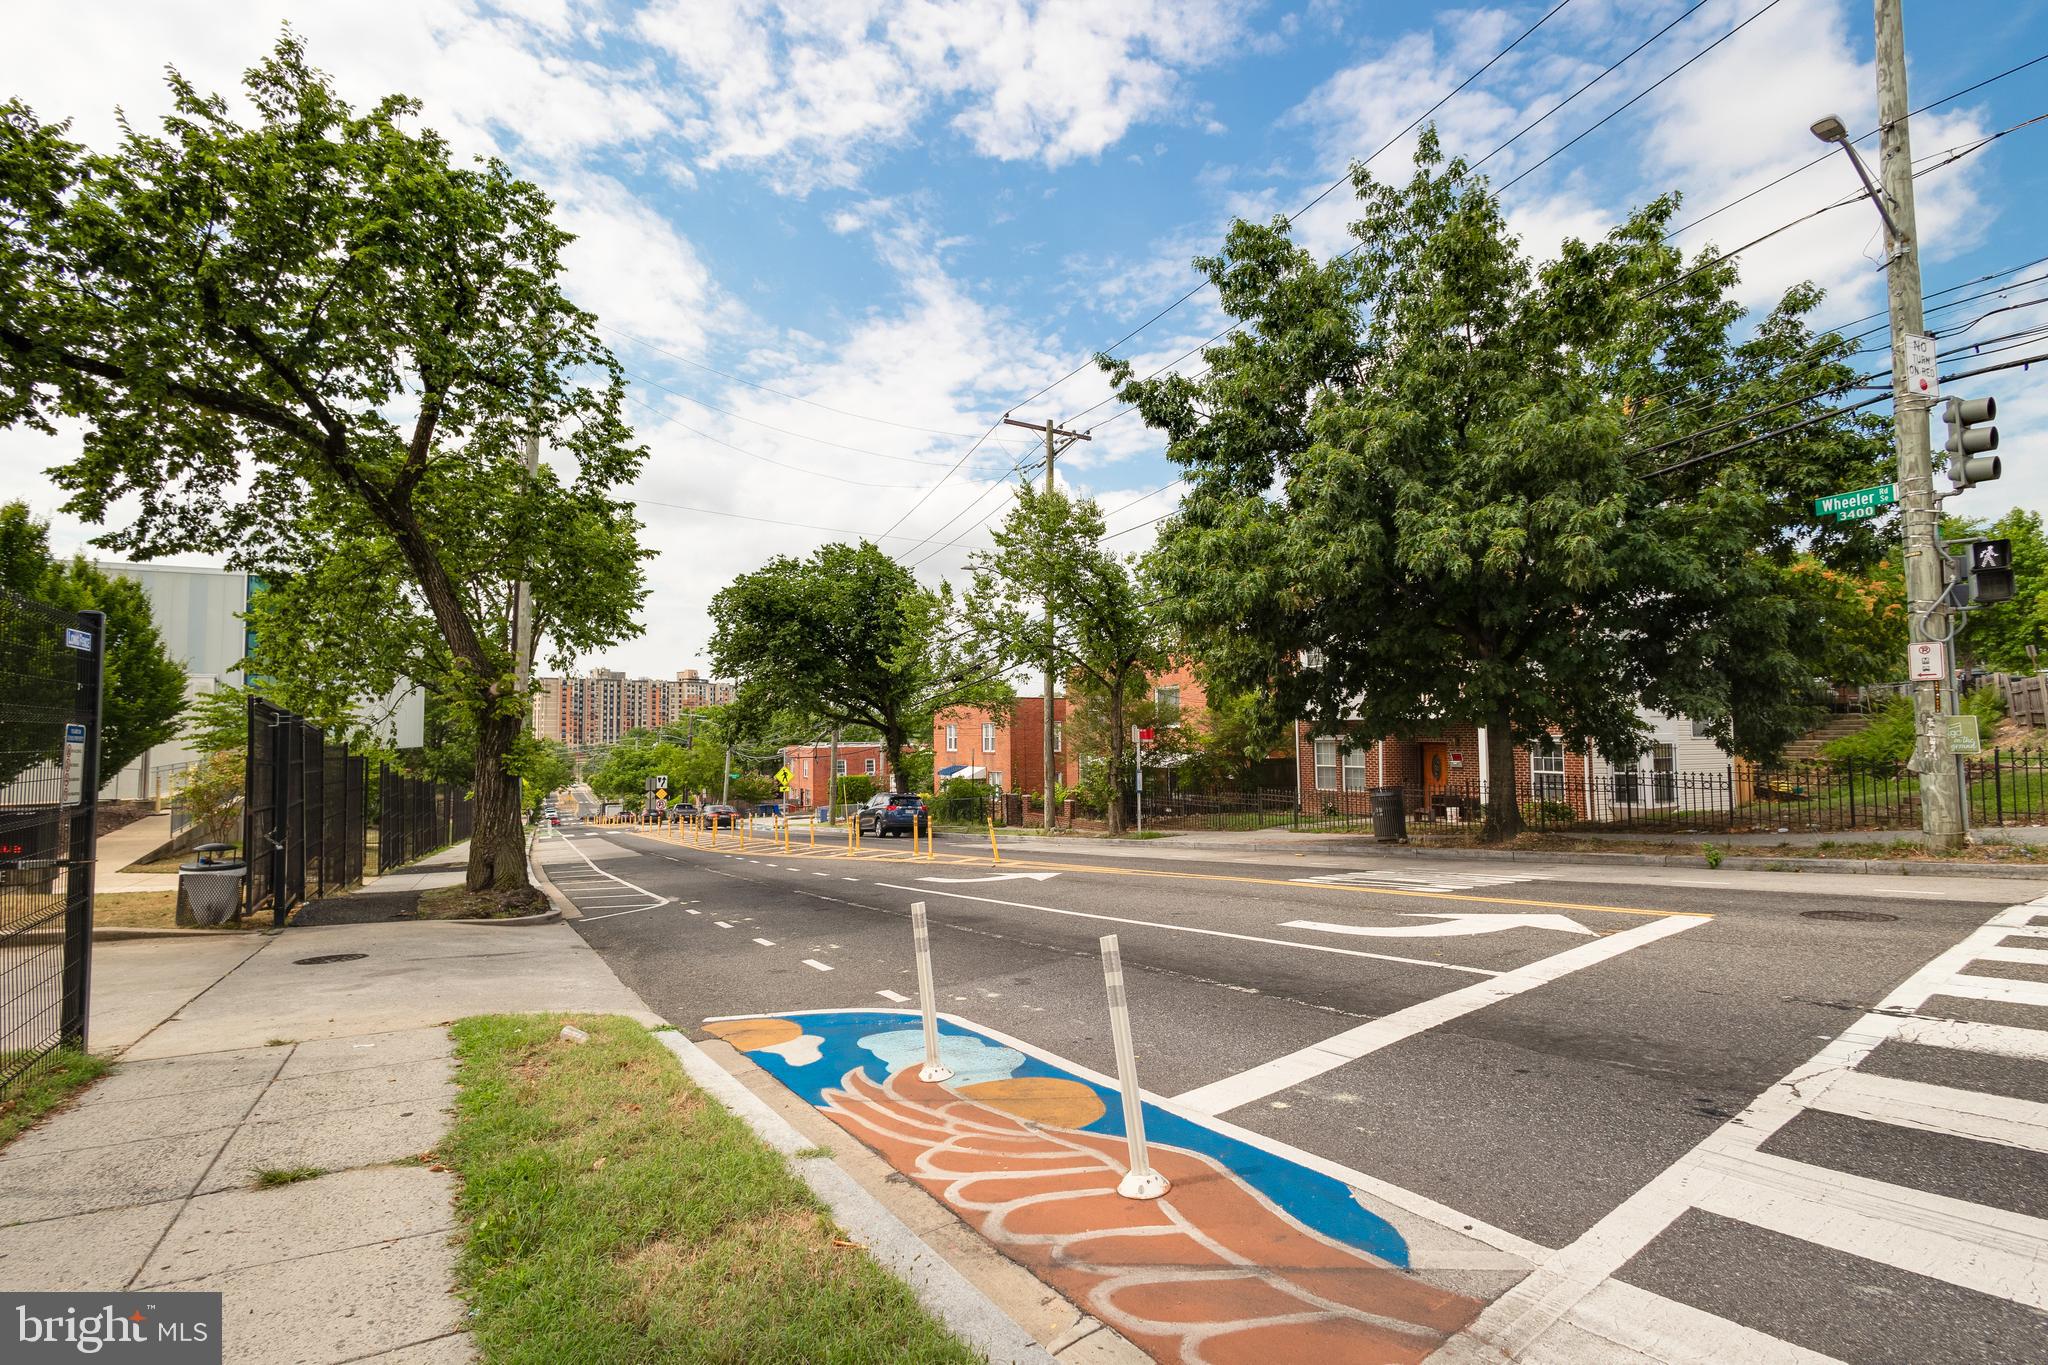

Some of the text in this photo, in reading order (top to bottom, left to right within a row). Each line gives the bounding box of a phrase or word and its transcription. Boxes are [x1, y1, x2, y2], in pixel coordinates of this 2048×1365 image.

[1913, 340, 1927, 352] NO
[1912, 354, 1931, 366] TURN
[1909, 365, 1935, 378] ON RED
[1822, 487, 1889, 512] Wheeler Rd
[1840, 507, 1873, 520] 3400
